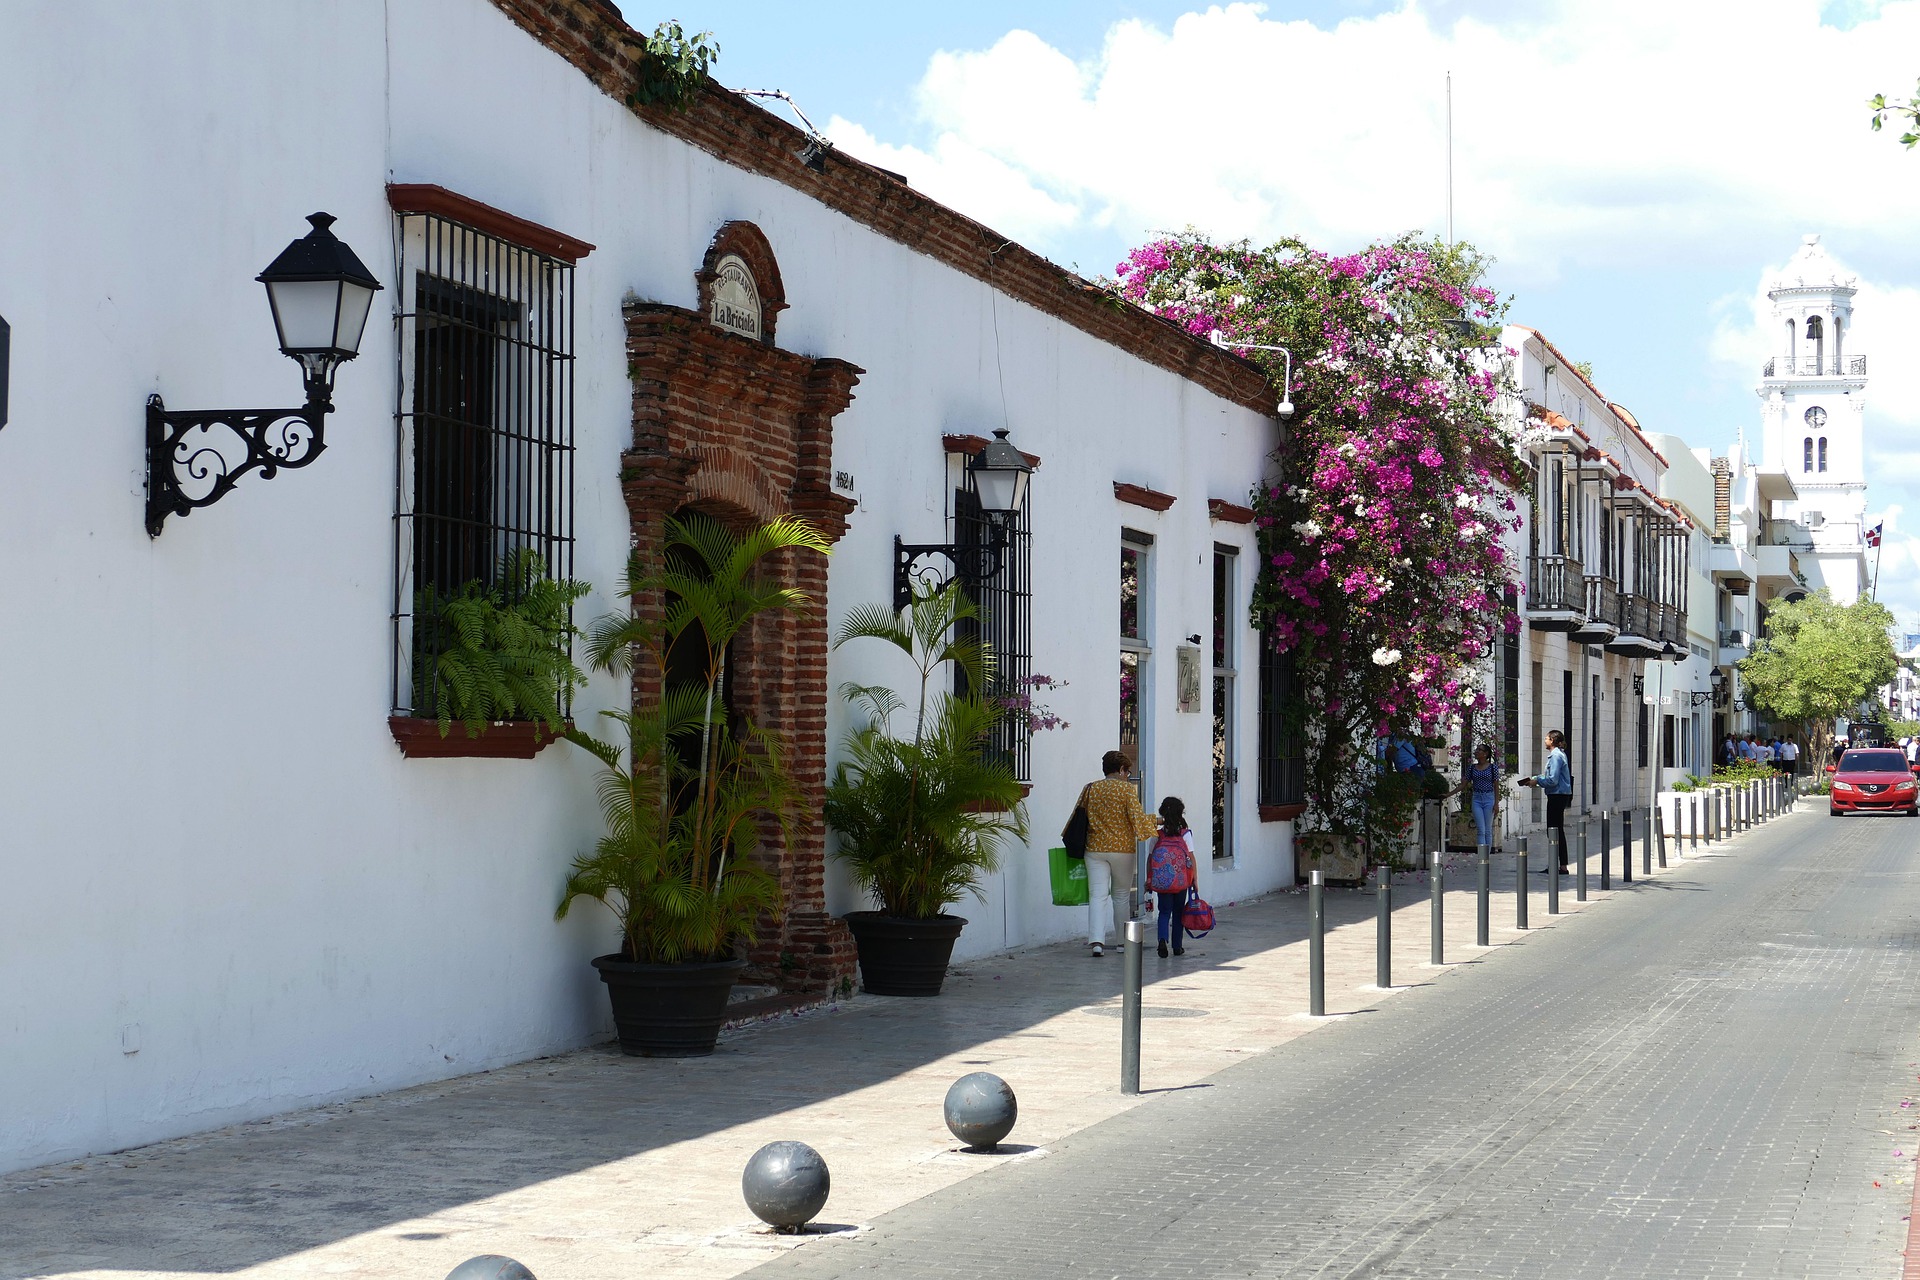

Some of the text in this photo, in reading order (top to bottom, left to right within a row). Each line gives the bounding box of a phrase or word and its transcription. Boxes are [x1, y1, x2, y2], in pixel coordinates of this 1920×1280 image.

[718, 269, 754, 305] RESTAURANTE
[715, 303, 755, 333] La Briciola
